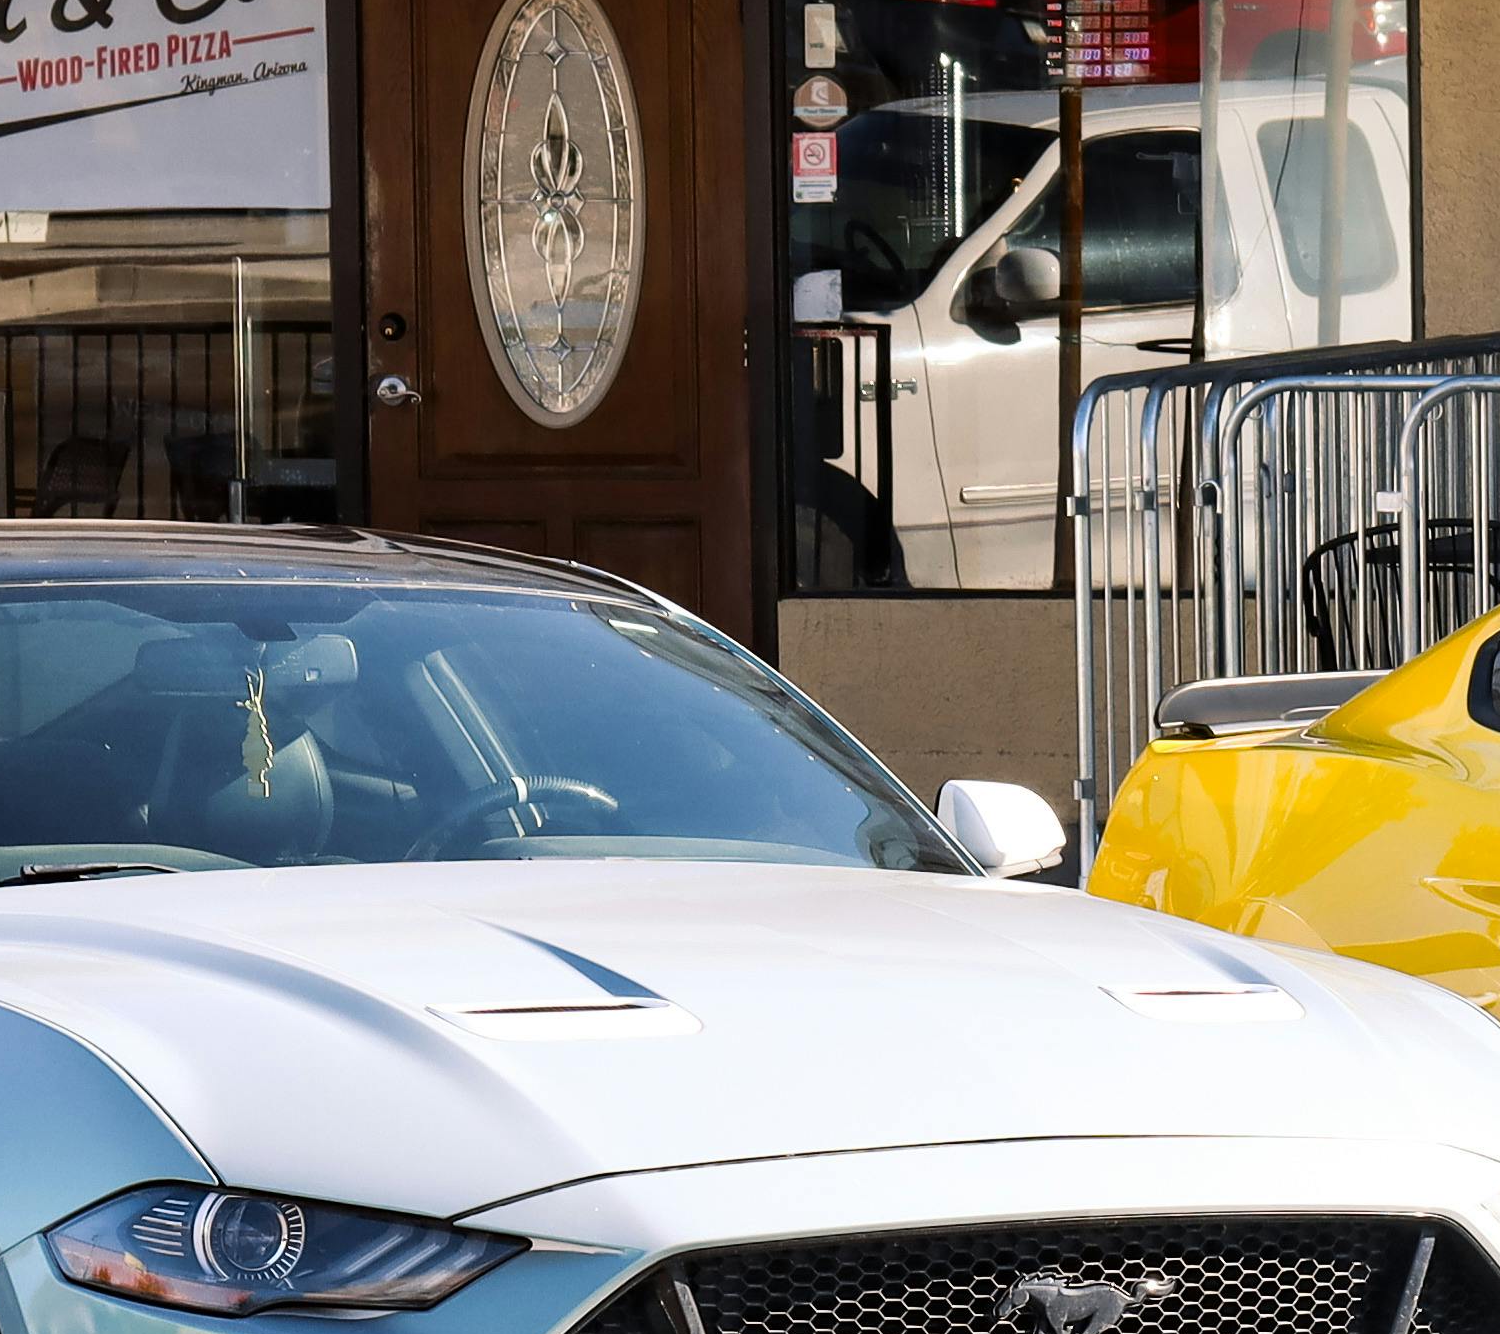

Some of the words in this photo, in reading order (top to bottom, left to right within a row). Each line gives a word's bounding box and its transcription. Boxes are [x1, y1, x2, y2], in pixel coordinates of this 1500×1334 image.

[16, 42, 160, 93] WOOD-FIRED
[166, 30, 232, 68] PIZZA
[253, 61, 308, 81] Arizona
